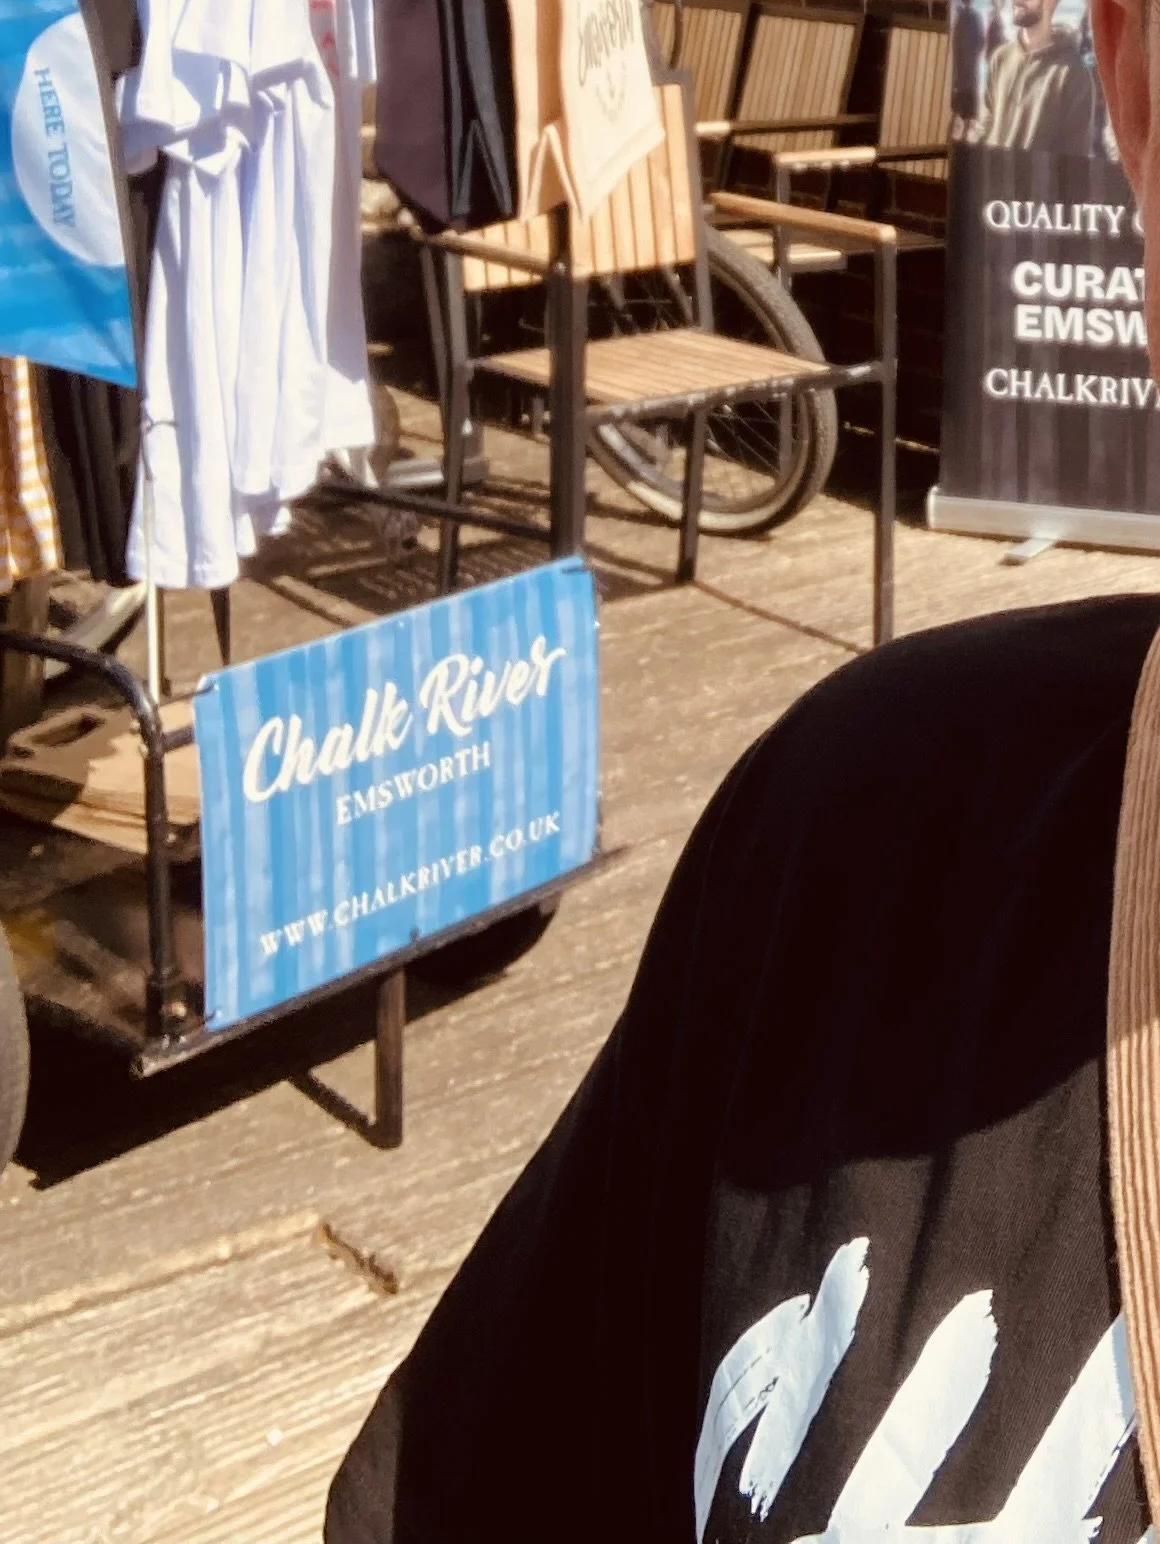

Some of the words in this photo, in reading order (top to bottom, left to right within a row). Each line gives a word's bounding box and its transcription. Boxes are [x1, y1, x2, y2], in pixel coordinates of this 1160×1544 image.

[33, 66, 66, 138] HERE
[47, 141, 77, 229] TODAY
[983, 199, 1126, 235] QUALITY
[242, 680, 415, 805] Chalk
[419, 634, 567, 739] River
[334, 739, 493, 827] EMSWORTH
[259, 810, 562, 957] WWW.CHALKRIVER.CO.UK
